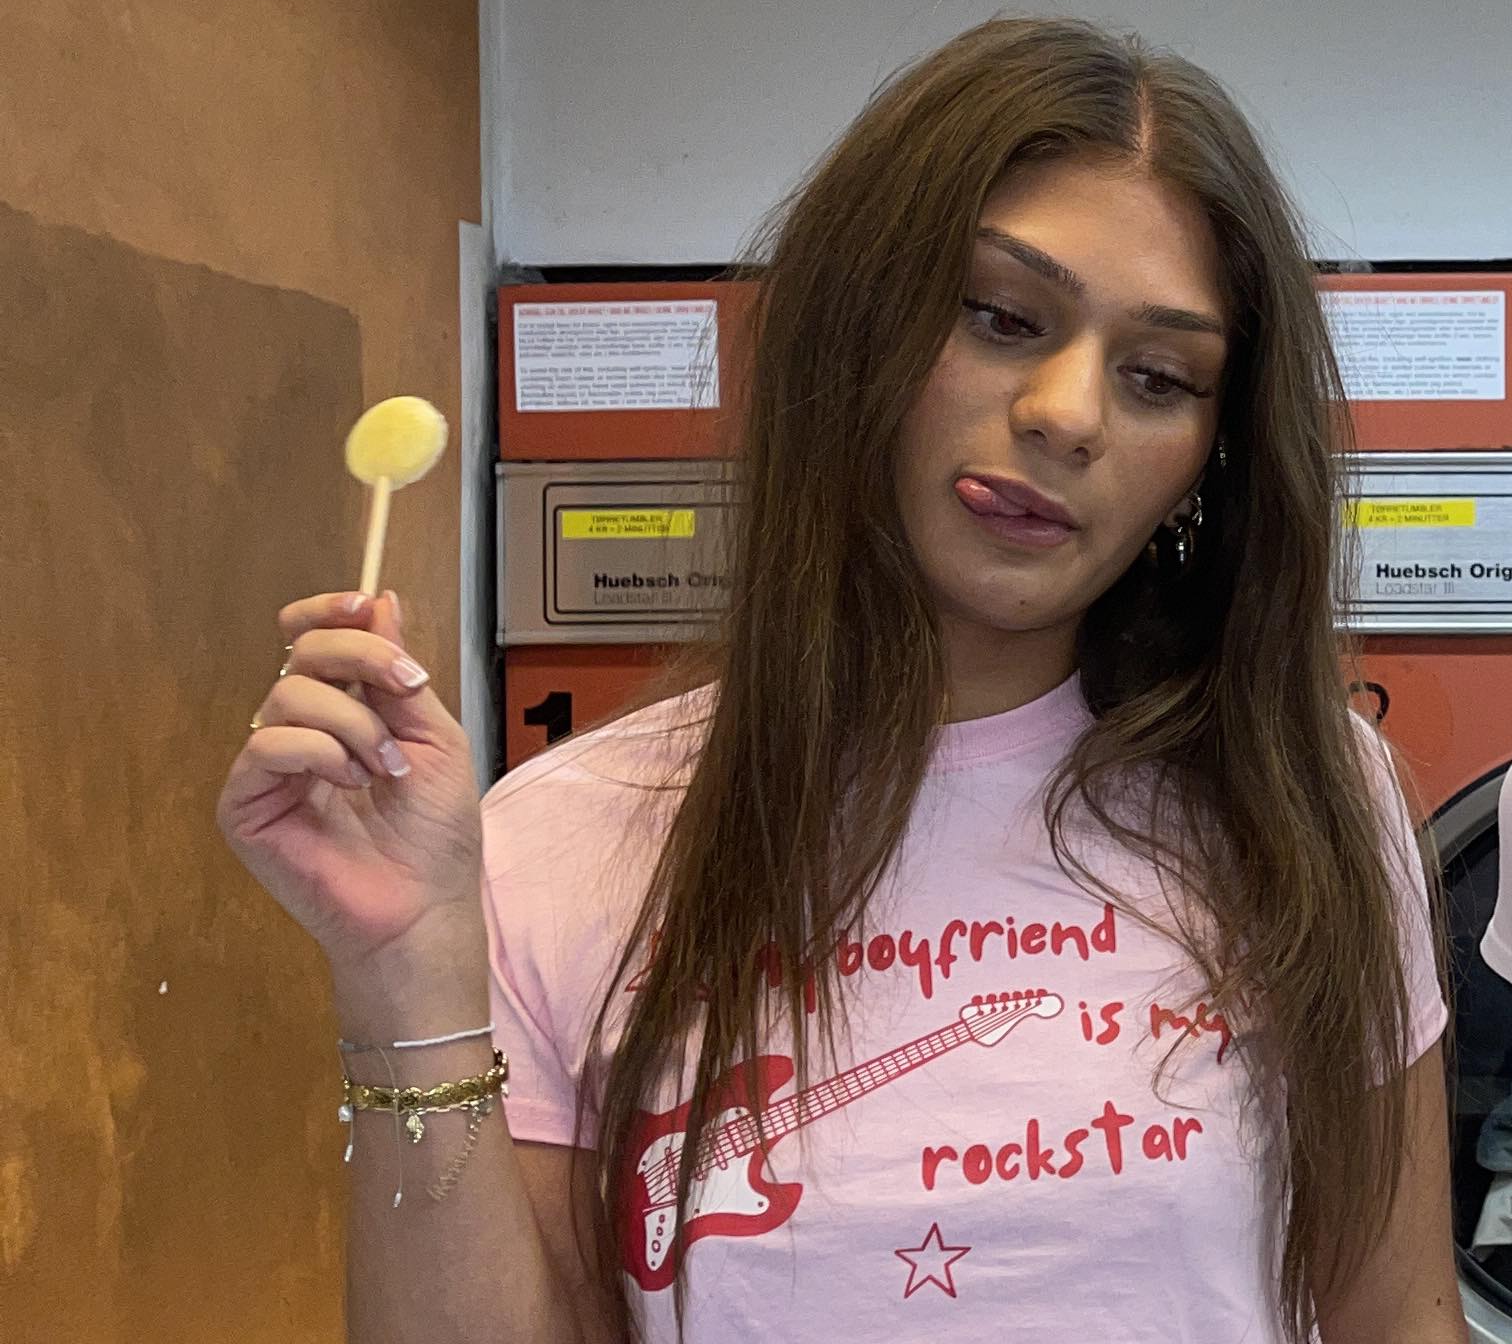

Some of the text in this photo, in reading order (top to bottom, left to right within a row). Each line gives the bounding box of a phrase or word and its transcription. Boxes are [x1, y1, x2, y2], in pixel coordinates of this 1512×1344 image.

[594, 572, 680, 588] Huebsch
[1376, 563, 1462, 579] Huebsch
[524, 690, 573, 745] 1
[838, 903, 1117, 999] boyfriend
[1078, 999, 1234, 1065] is my
[921, 1100, 1204, 1191] rockstar
